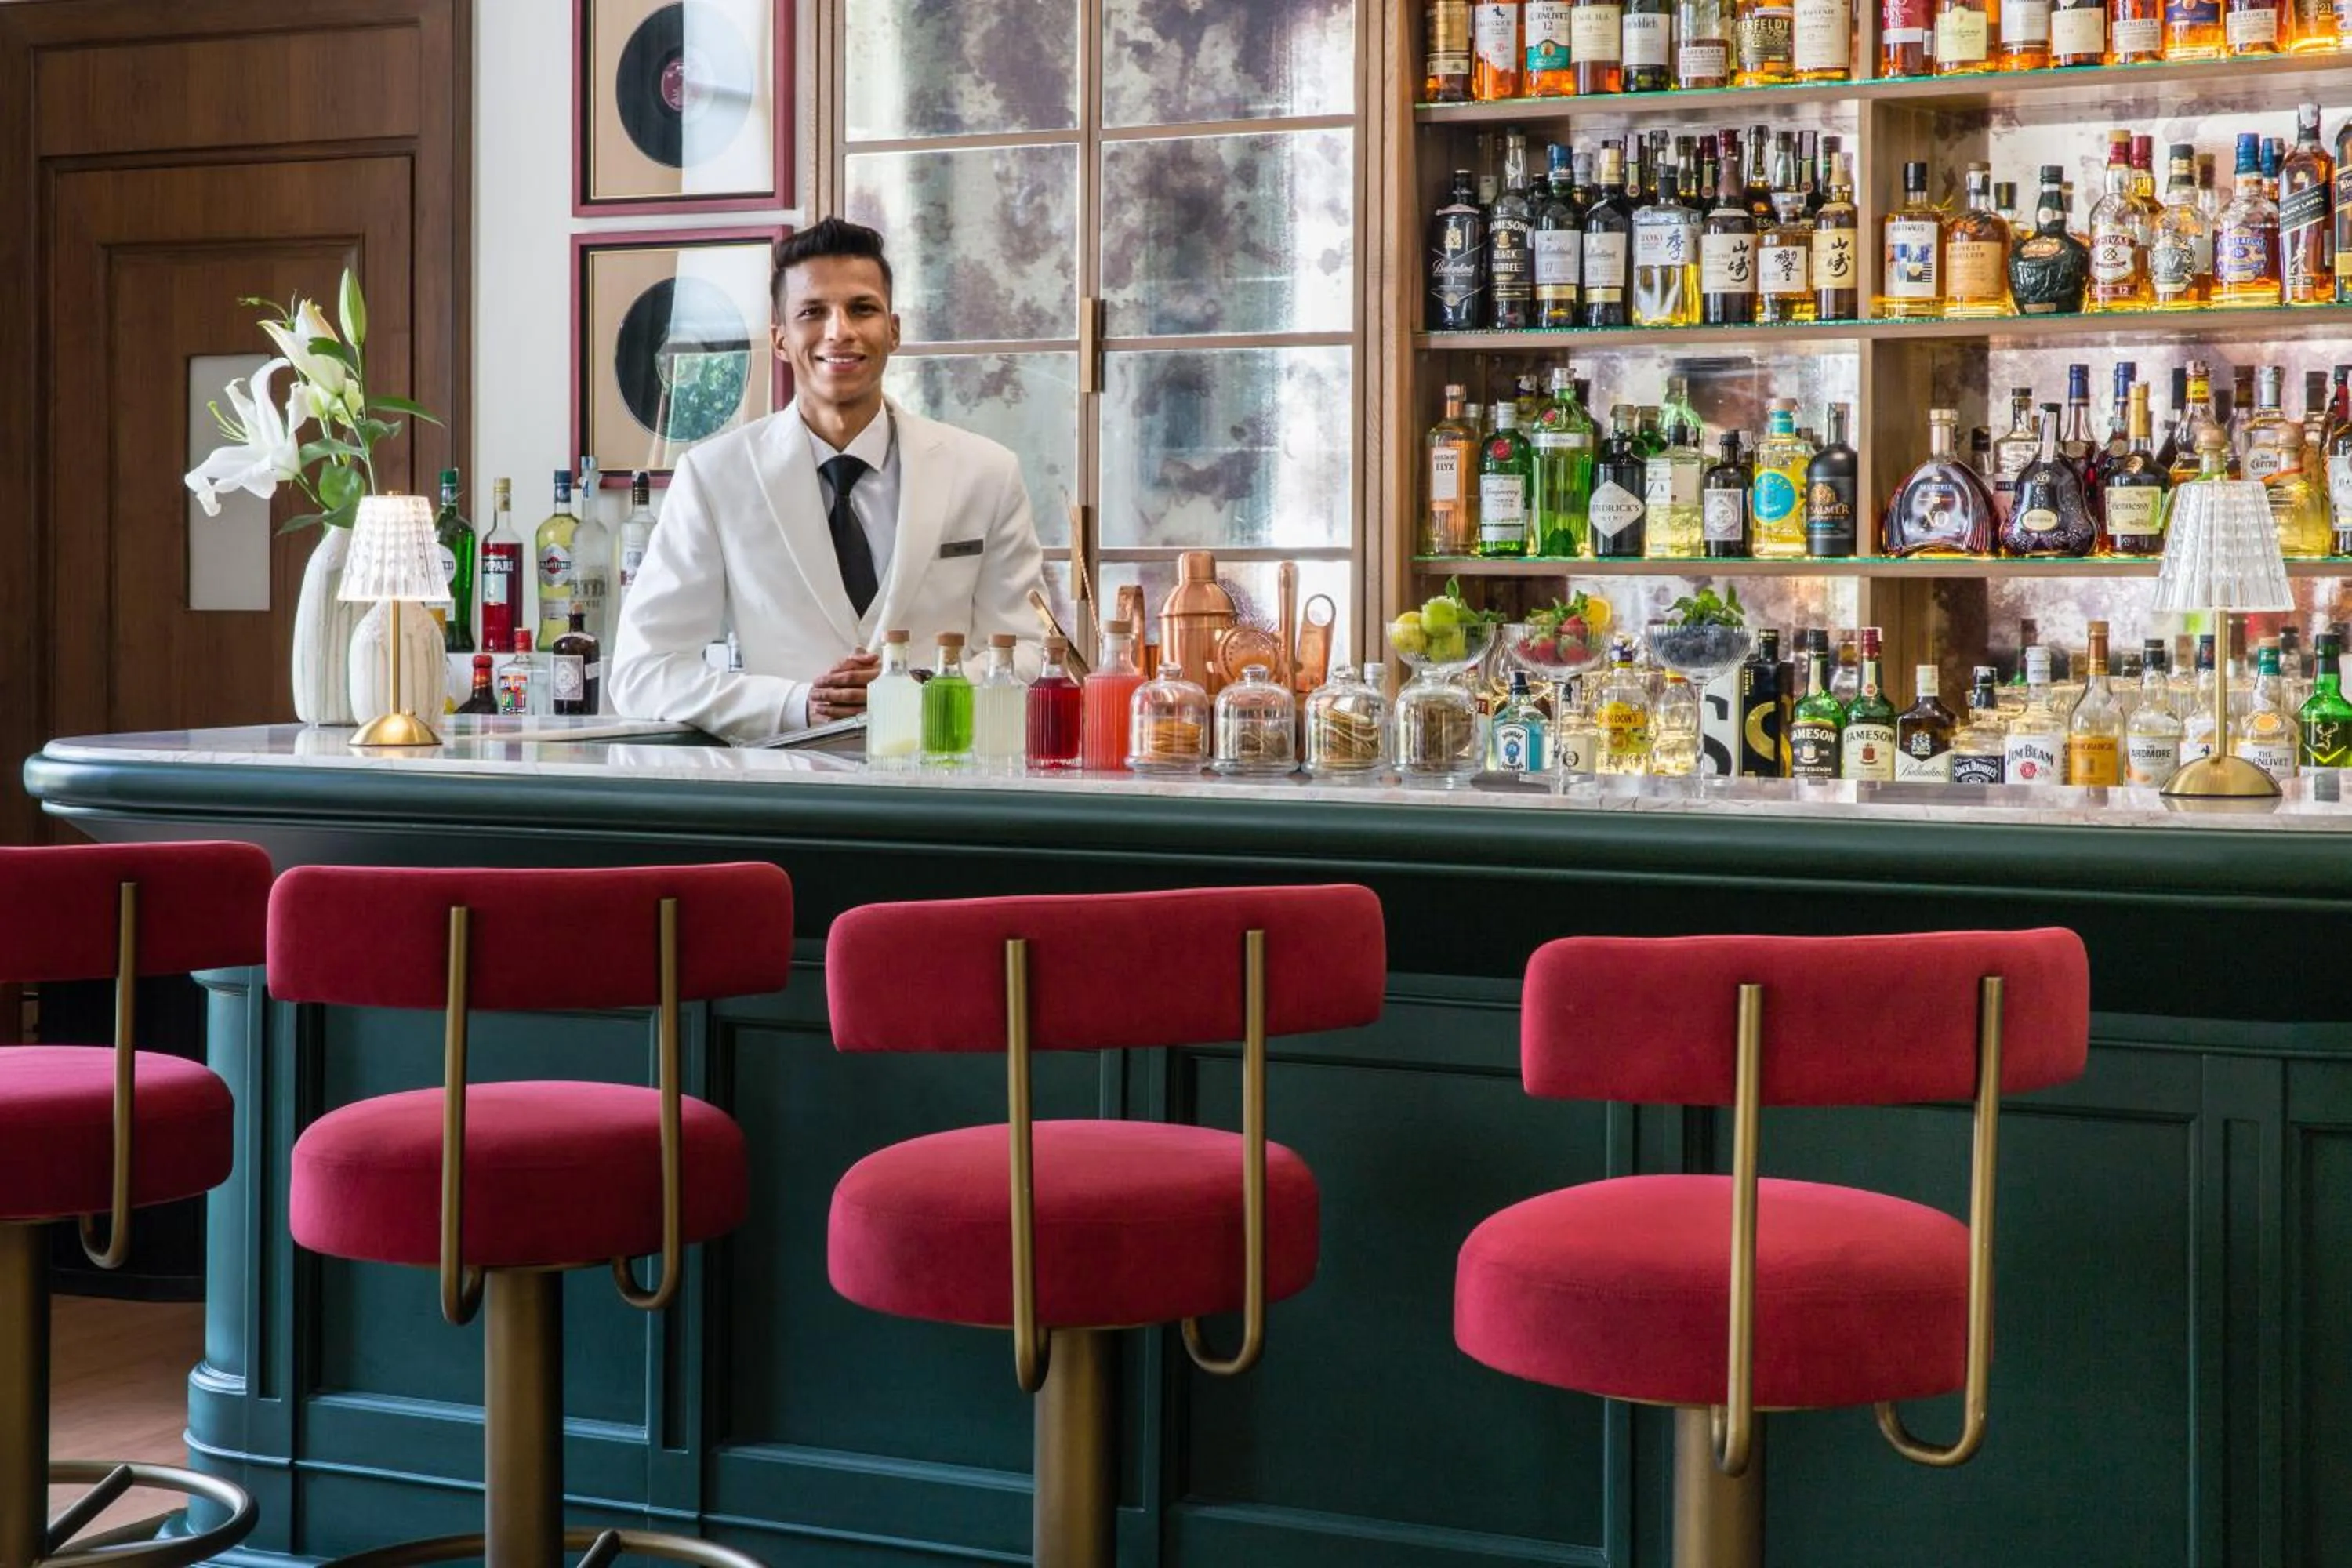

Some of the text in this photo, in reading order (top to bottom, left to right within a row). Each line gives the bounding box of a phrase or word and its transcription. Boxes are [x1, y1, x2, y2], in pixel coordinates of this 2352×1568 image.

[1489, 220, 1528, 234] AMESON
[1436, 463, 1454, 471] ELYX
[481, 561, 514, 572] MPARI
[1792, 728, 1837, 743] AMESON
[1846, 730, 1895, 744] JAMESON
[2007, 744, 2053, 767] JIM BEAM
